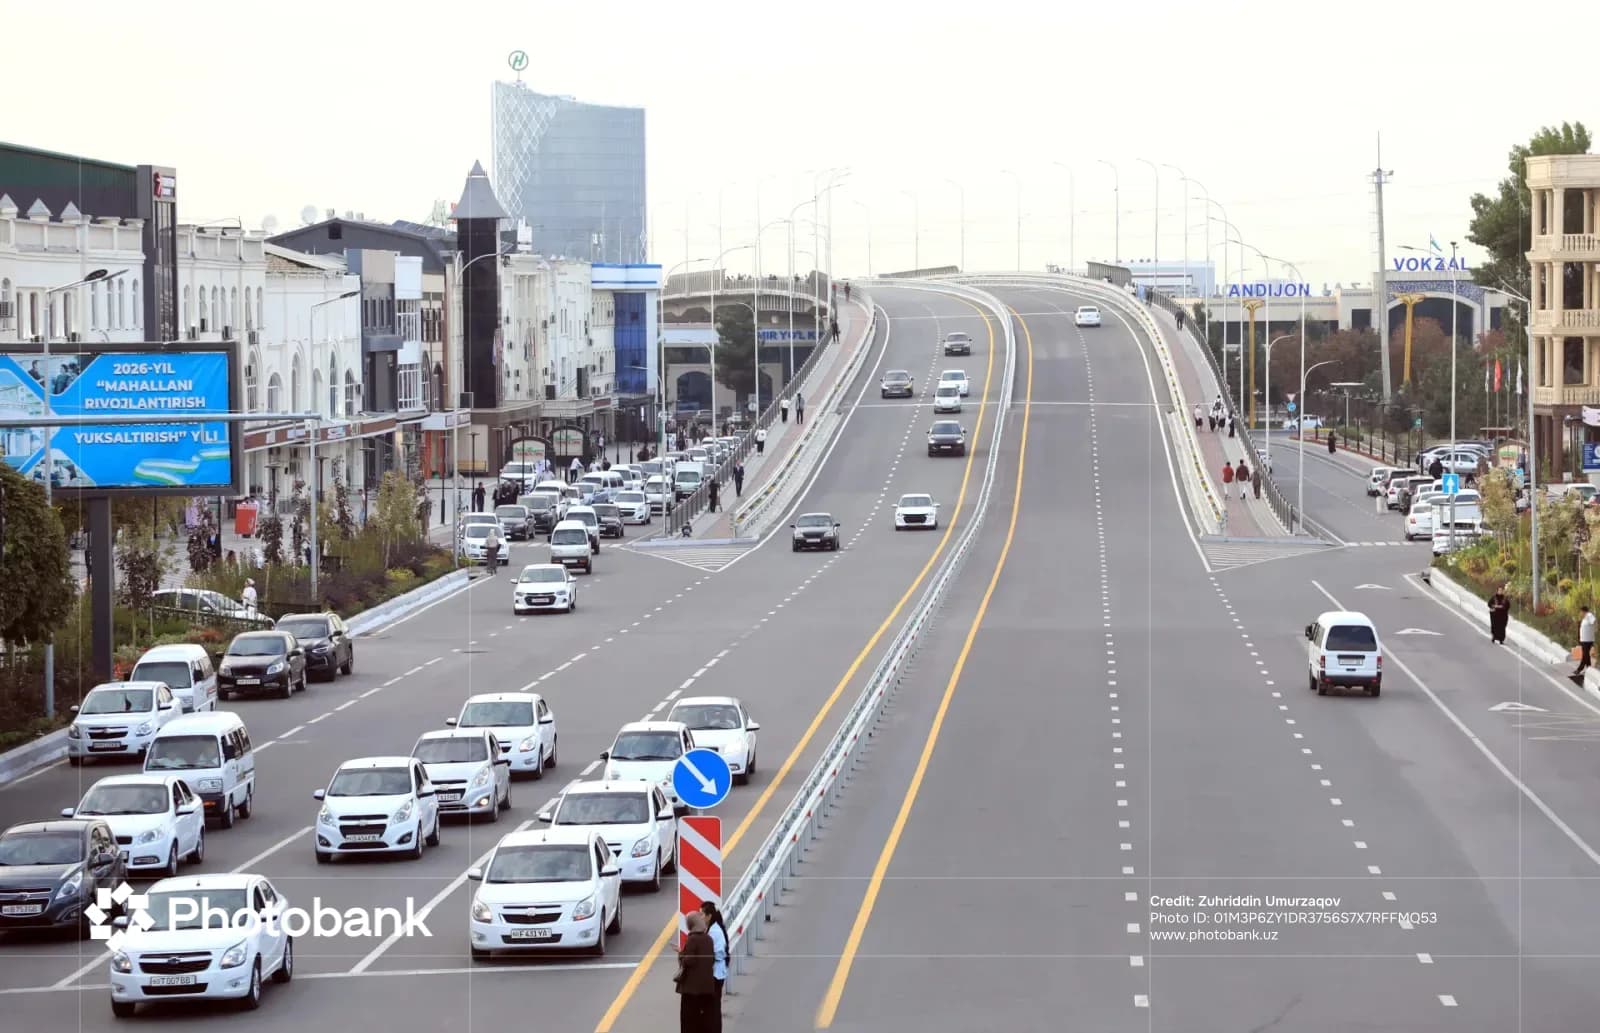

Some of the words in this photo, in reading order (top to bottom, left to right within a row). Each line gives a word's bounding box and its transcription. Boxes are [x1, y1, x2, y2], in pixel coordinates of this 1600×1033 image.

[1393, 257, 1470, 271] VOKZAL
[1229, 283, 1311, 297] ANDIJON
[113, 363, 176, 375] 2026-YIL
[85, 397, 206, 409] RIVOJLANTIRISH
[191, 430, 218, 442] YILI
